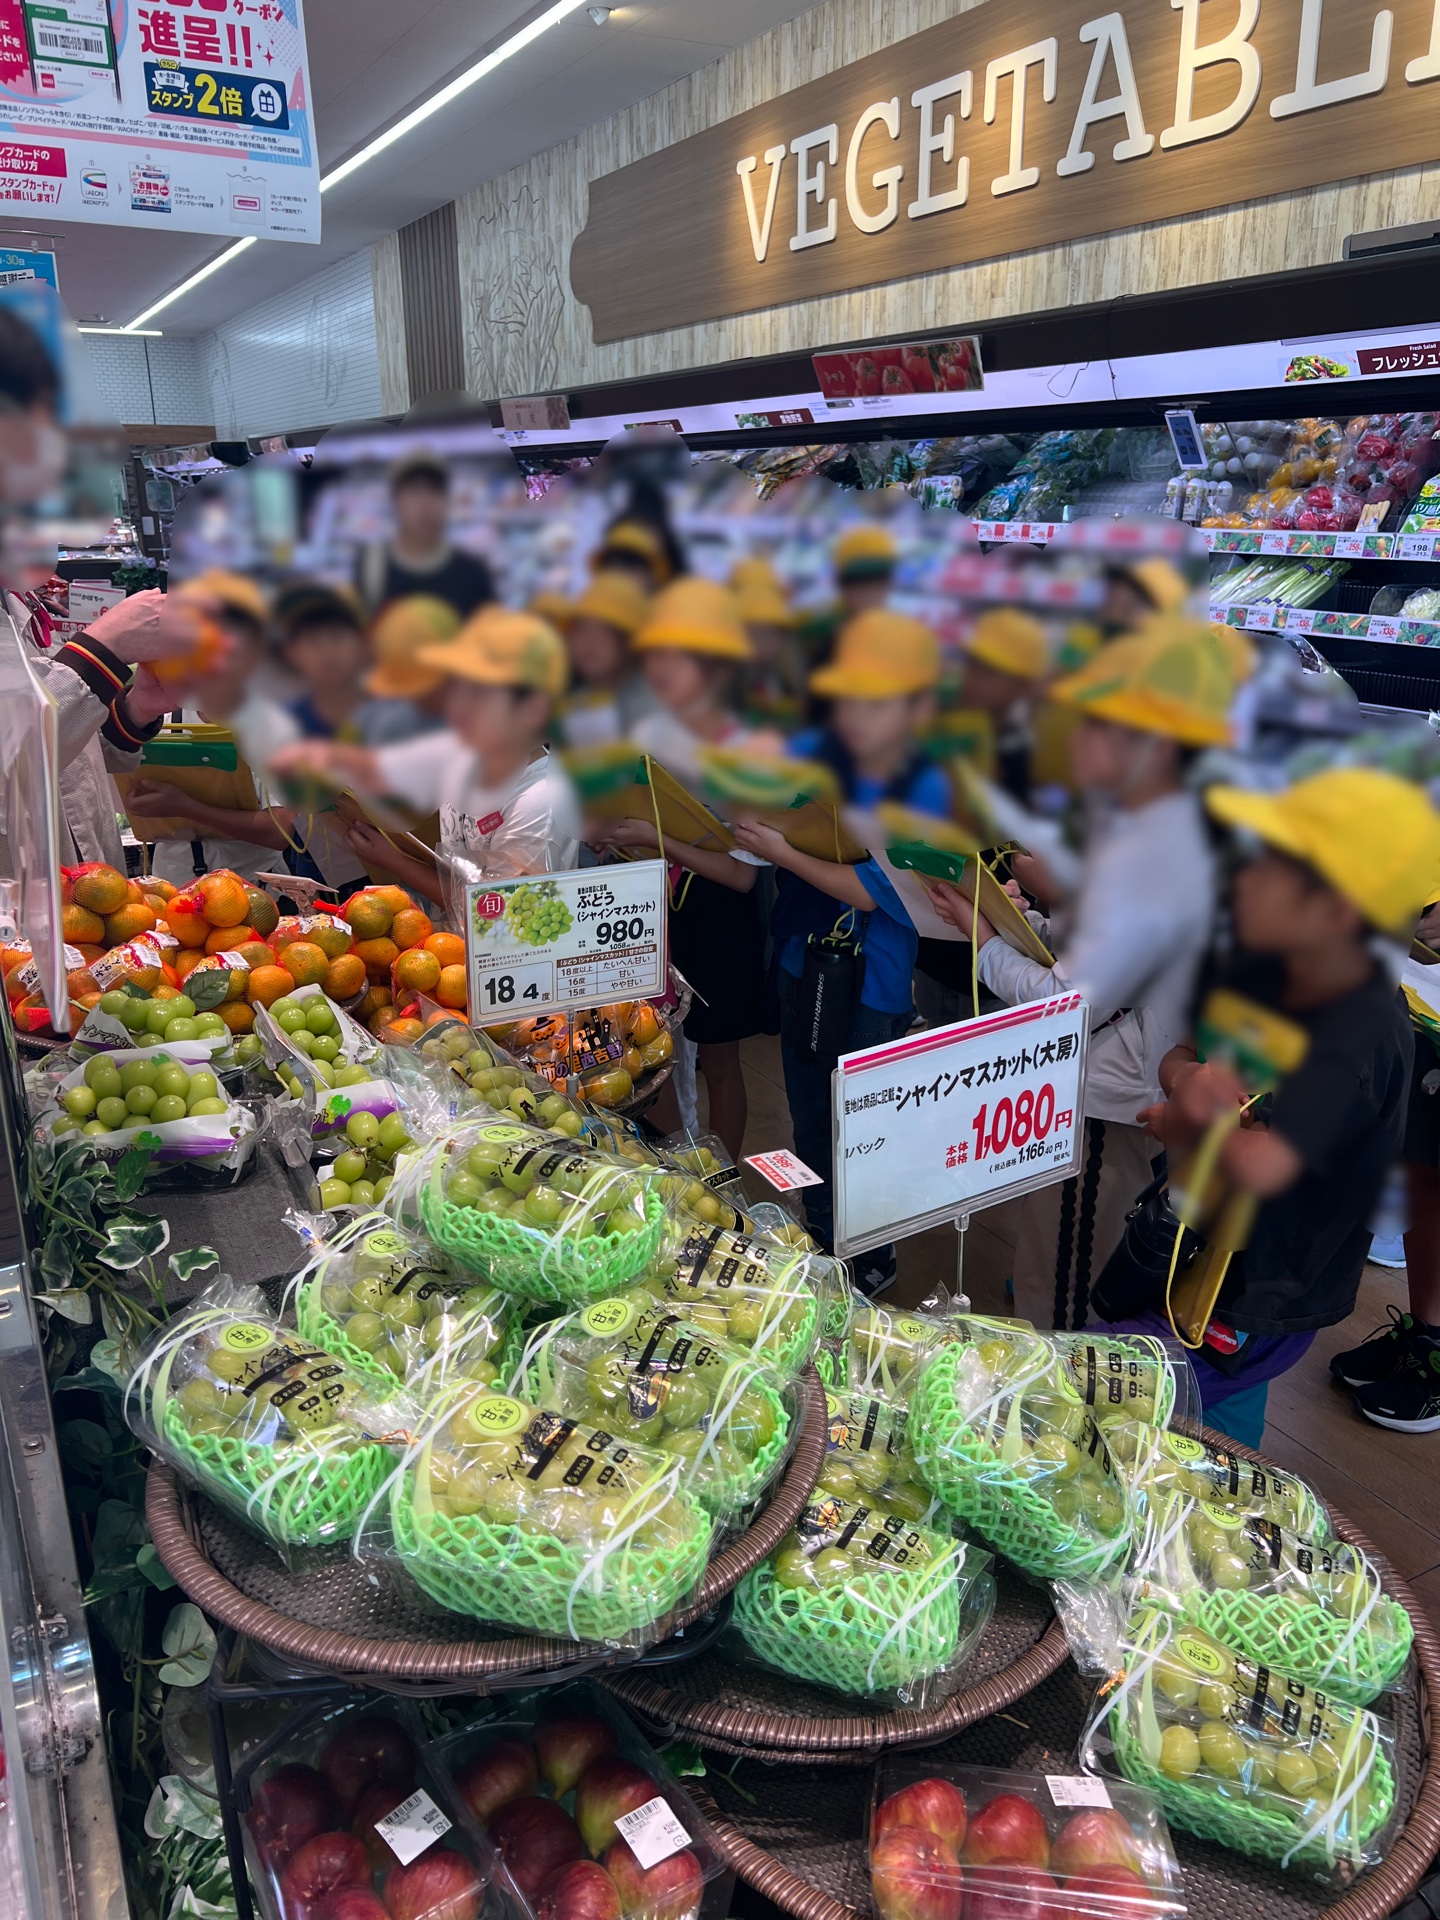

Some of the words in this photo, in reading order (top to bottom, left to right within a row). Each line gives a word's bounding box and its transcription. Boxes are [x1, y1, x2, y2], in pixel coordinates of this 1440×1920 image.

[138, 8, 253, 69] 進呈!!
[736, 0, 1440, 262] VEGETABL
[1412, 544, 1428, 552] 198
[482, 895, 502, 914] 旬
[577, 892, 615, 909] ぶどう
[577, 900, 656, 923] (シャインマスカット)
[603, 955, 650, 970] たいへん甘い
[619, 969, 635, 978] 甘い
[610, 978, 643, 990] やや甘い
[810, 1021, 820, 1053] WIDE
[945, 1140, 969, 1157] 本体
[945, 1151, 969, 1169] 価格
